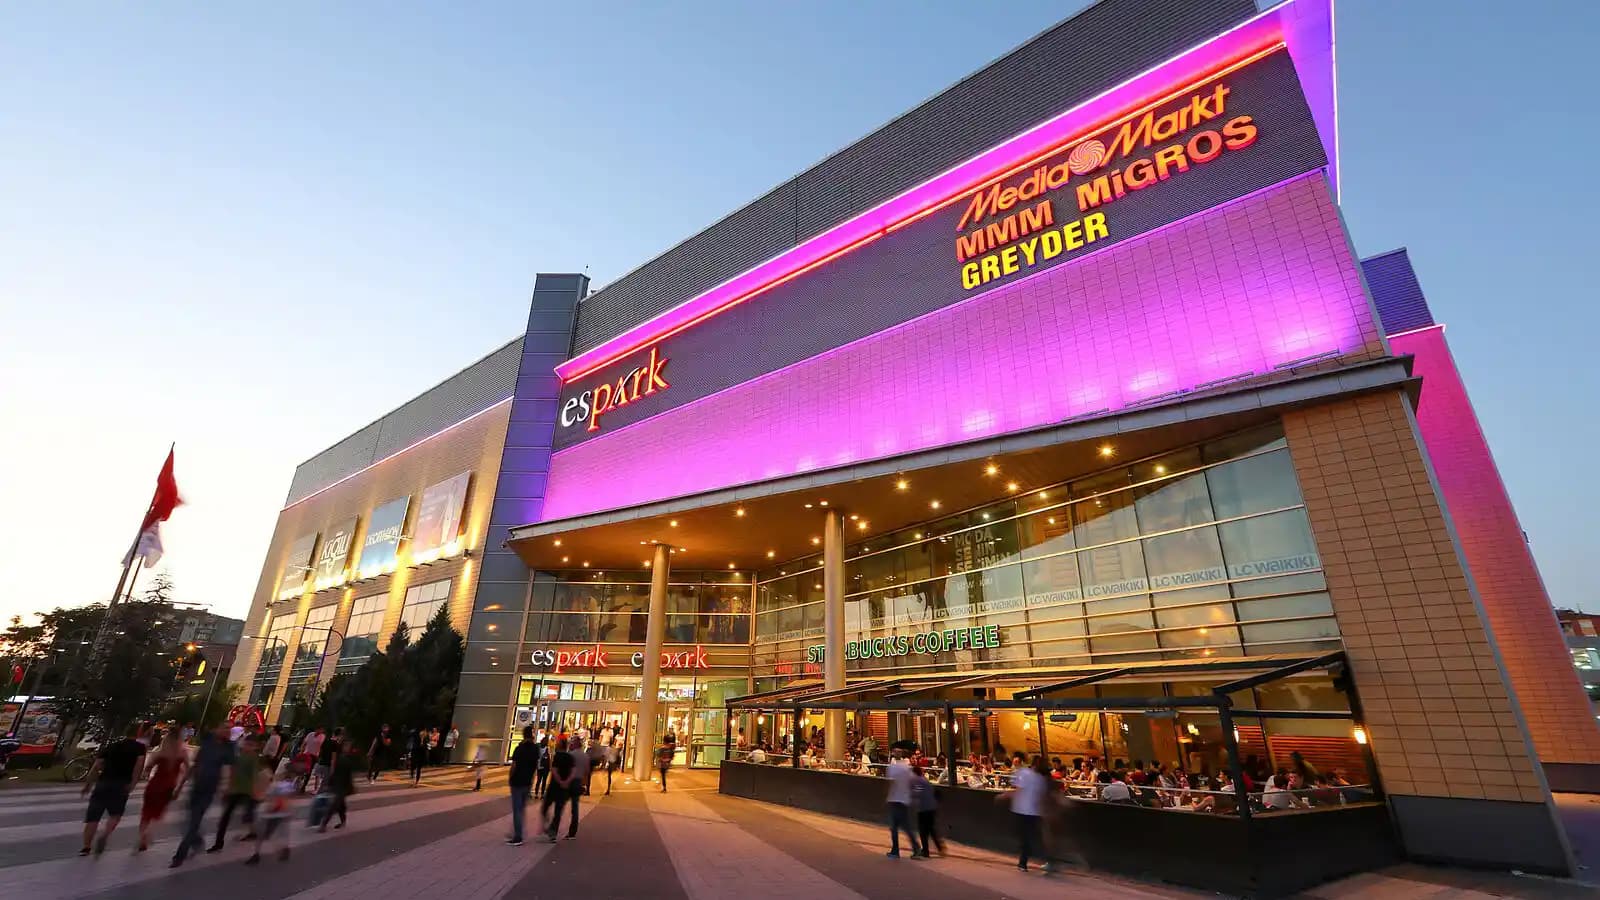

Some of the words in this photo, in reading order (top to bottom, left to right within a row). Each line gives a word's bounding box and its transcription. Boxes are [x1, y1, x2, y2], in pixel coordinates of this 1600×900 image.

[957, 160, 1070, 231] Media
[1099, 84, 1230, 167] Markt
[955, 199, 1054, 263] MMM
[961, 212, 1110, 290] GREYDER
[561, 347, 671, 432] espark
[1155, 576, 1170, 588] LC
[1235, 564, 1253, 577] LC
[1087, 585, 1101, 597] LC
[531, 644, 609, 674] espark
[808, 635, 909, 664] STBUCKS
[913, 624, 1001, 654] COFFEE
